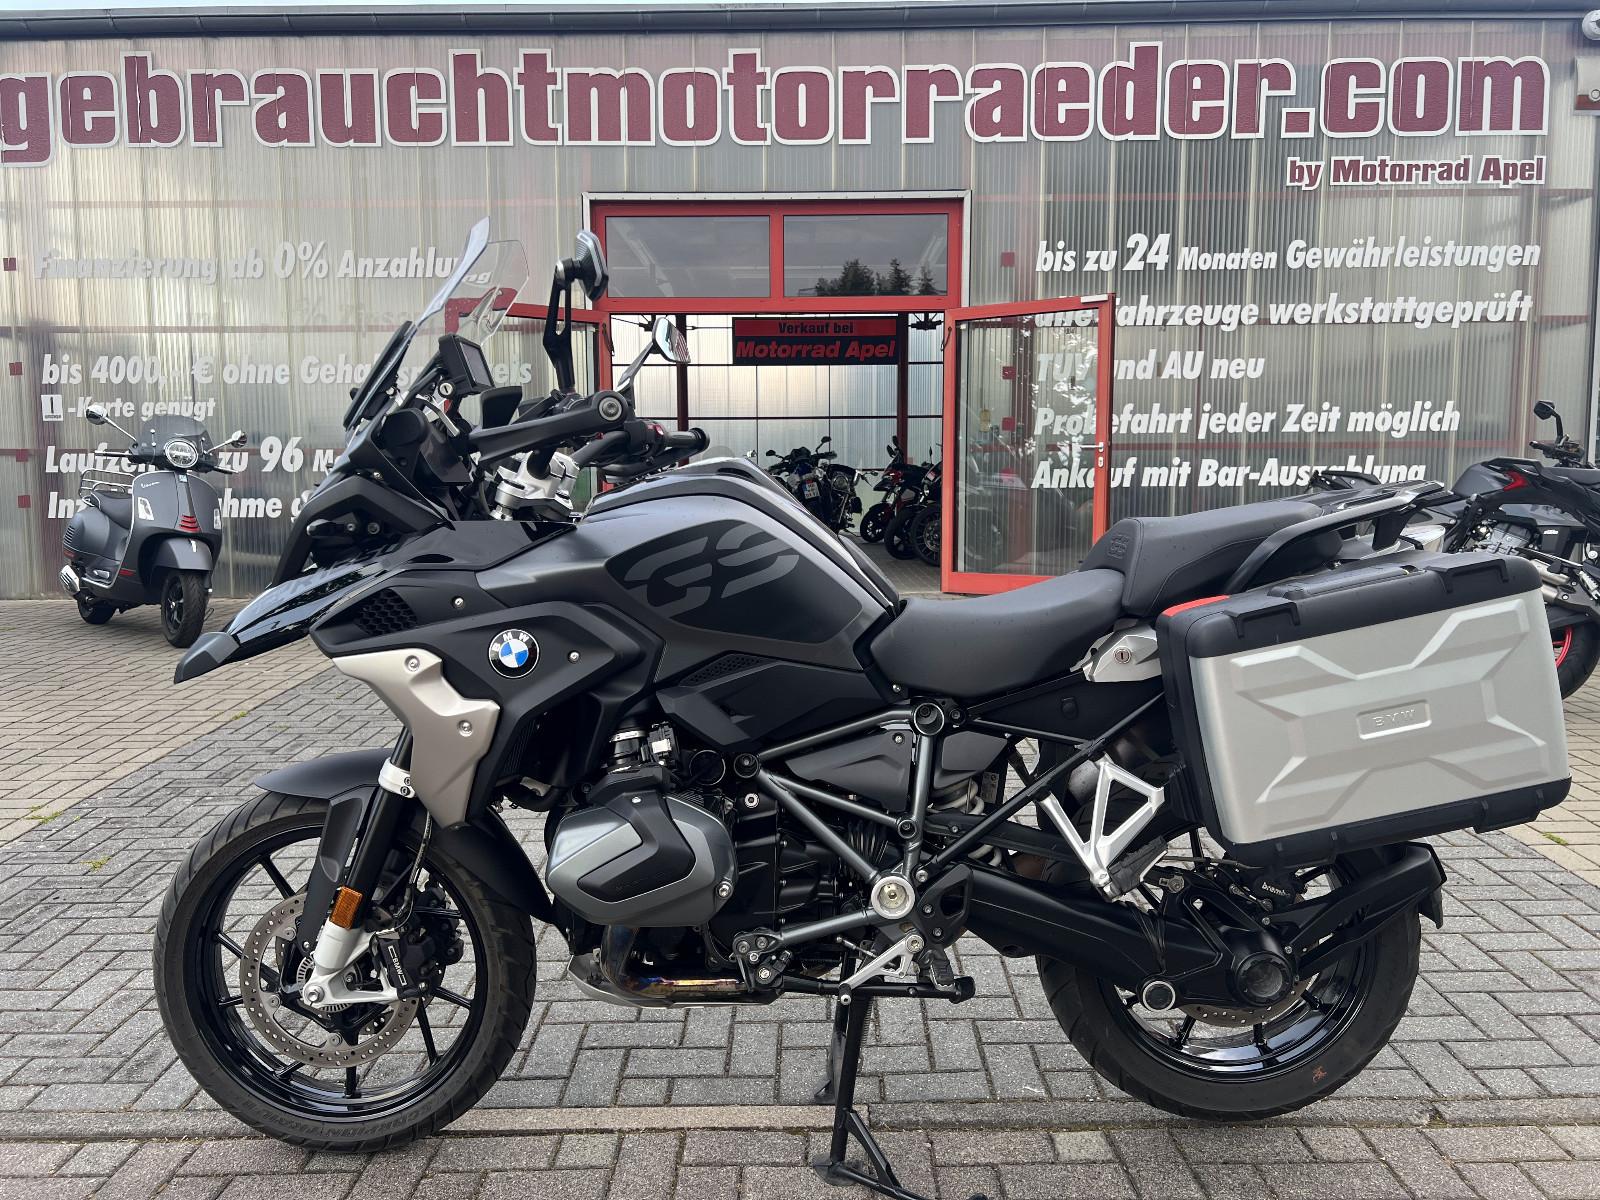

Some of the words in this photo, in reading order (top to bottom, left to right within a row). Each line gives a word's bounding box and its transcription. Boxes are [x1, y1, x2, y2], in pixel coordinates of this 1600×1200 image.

[0, 41, 1550, 168] gebrauchtmotorraeder.com
[1287, 157, 1325, 190] by
[1330, 155, 1473, 186] Motorrad
[1477, 154, 1547, 188] Apel
[34, 250, 219, 286] Finanzierung
[231, 248, 264, 279] ab
[274, 238, 330, 279] 0%
[1035, 240, 1077, 272] bis
[1083, 250, 1117, 272] zu
[1123, 233, 1171, 271] 24
[1177, 246, 1278, 271] Monaten
[1286, 235, 1541, 273] Gewährleistungen
[1094, 294, 1259, 332] ahrzeuge
[1270, 290, 1533, 328] werkstattgeprüft
[778, 322, 831, 334] Verkauf
[833, 322, 854, 334] bei
[735, 340, 841, 358] Motorrad
[844, 340, 896, 361] Apel
[1160, 351, 1205, 380] AU
[1210, 357, 1265, 380] neu
[42, 353, 82, 385] bis
[191, 355, 215, 384] €
[223, 354, 291, 385] ohne
[141, 397, 216, 422] genügt
[1198, 402, 1276, 440] jeder
[1281, 402, 1341, 433] Zeit
[1347, 401, 1460, 439] möglich
[219, 451, 248, 472] zu
[260, 436, 304, 473] 96
[1141, 457, 1191, 487] mit
[491, 632, 530, 653] BMW
[392, 957, 404, 976] BMW
